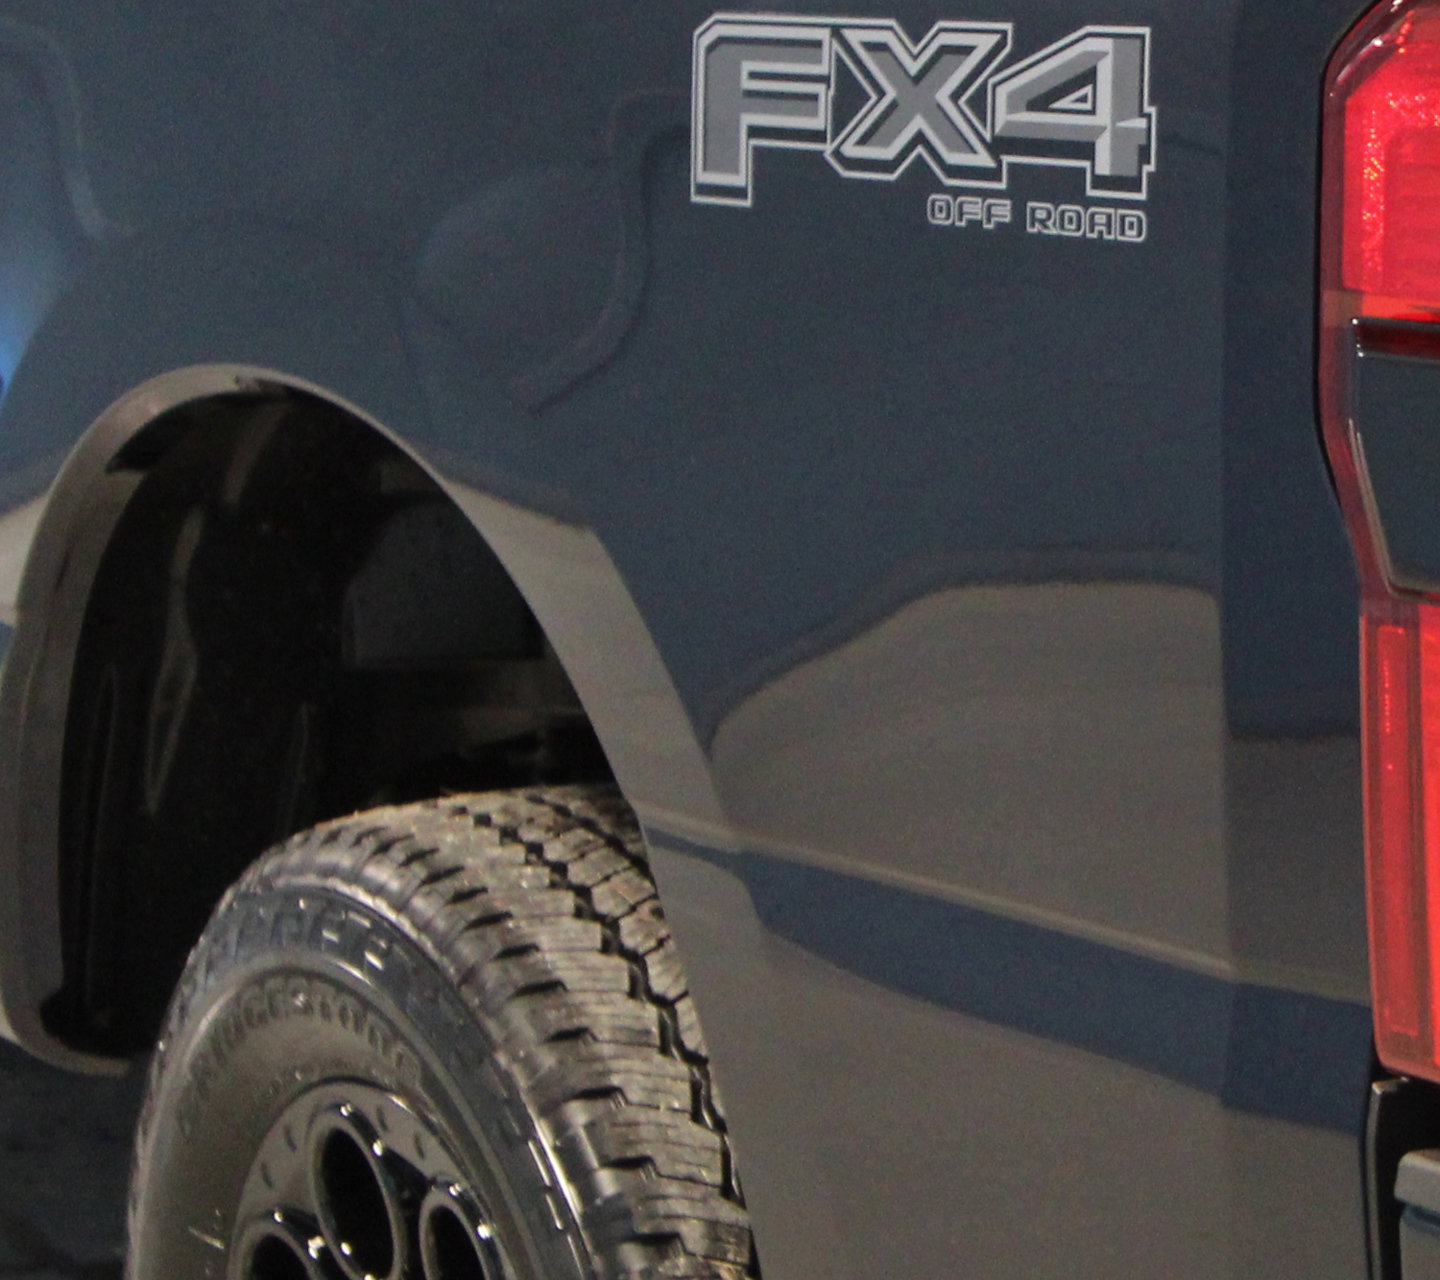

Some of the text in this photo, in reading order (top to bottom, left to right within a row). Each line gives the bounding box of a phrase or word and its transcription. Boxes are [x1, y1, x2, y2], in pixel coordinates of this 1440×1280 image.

[690, 11, 1156, 208] FX4
[926, 194, 1148, 243] OFF ROAD
